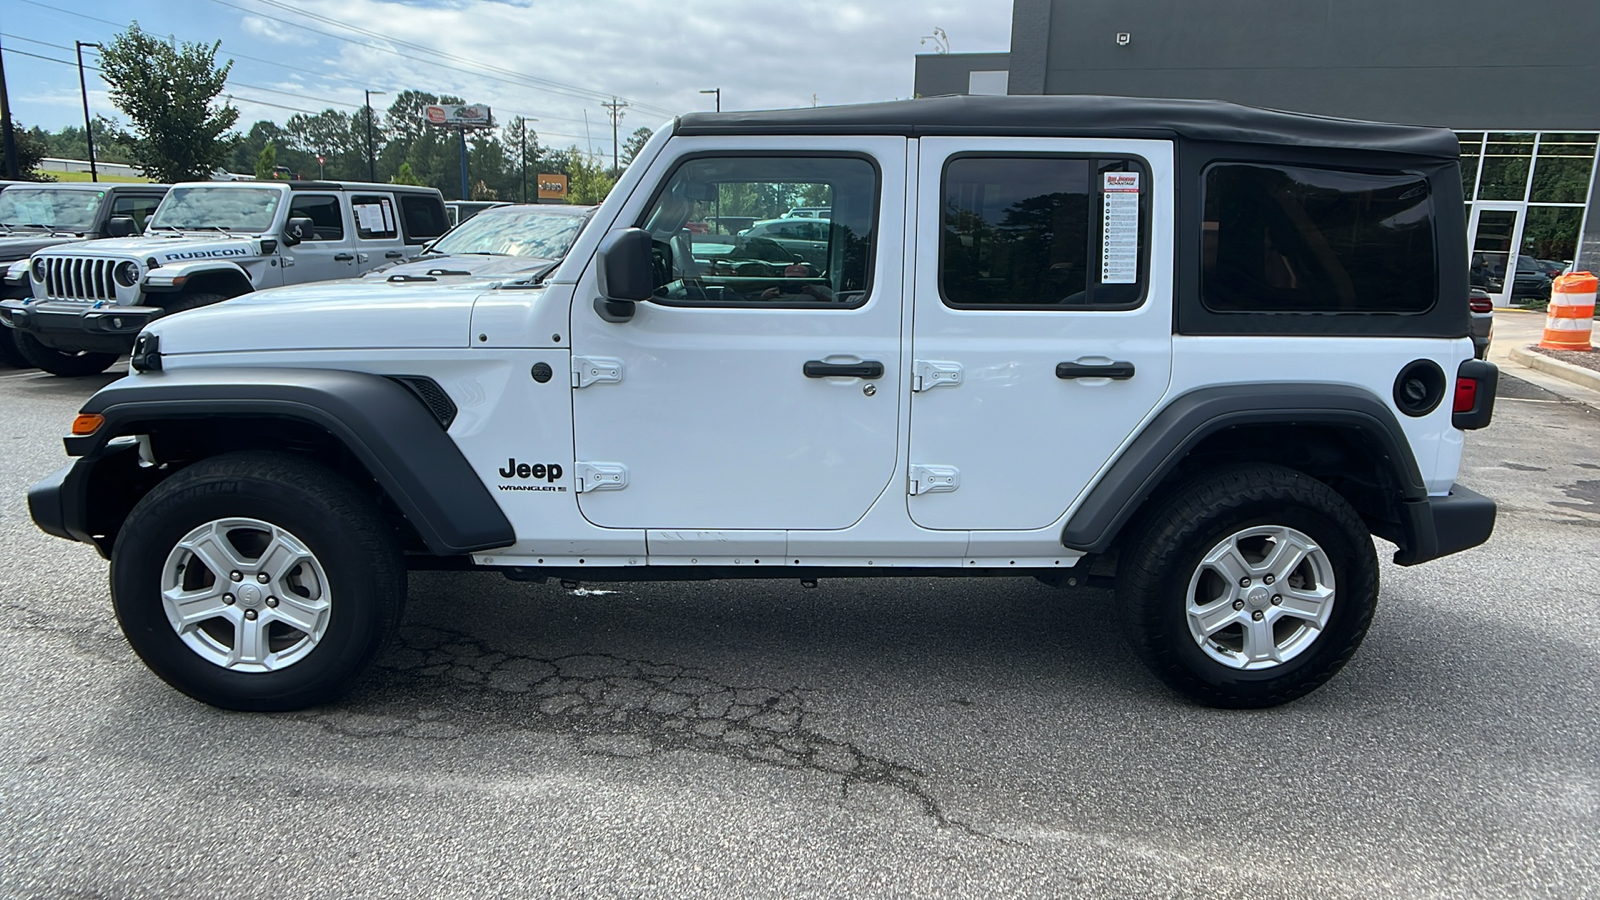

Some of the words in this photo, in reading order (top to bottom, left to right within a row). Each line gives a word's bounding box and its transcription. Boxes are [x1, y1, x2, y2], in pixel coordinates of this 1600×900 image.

[538, 180, 563, 191] Jeep
[165, 248, 247, 261] RUBICON
[499, 458, 563, 483] Jeep
